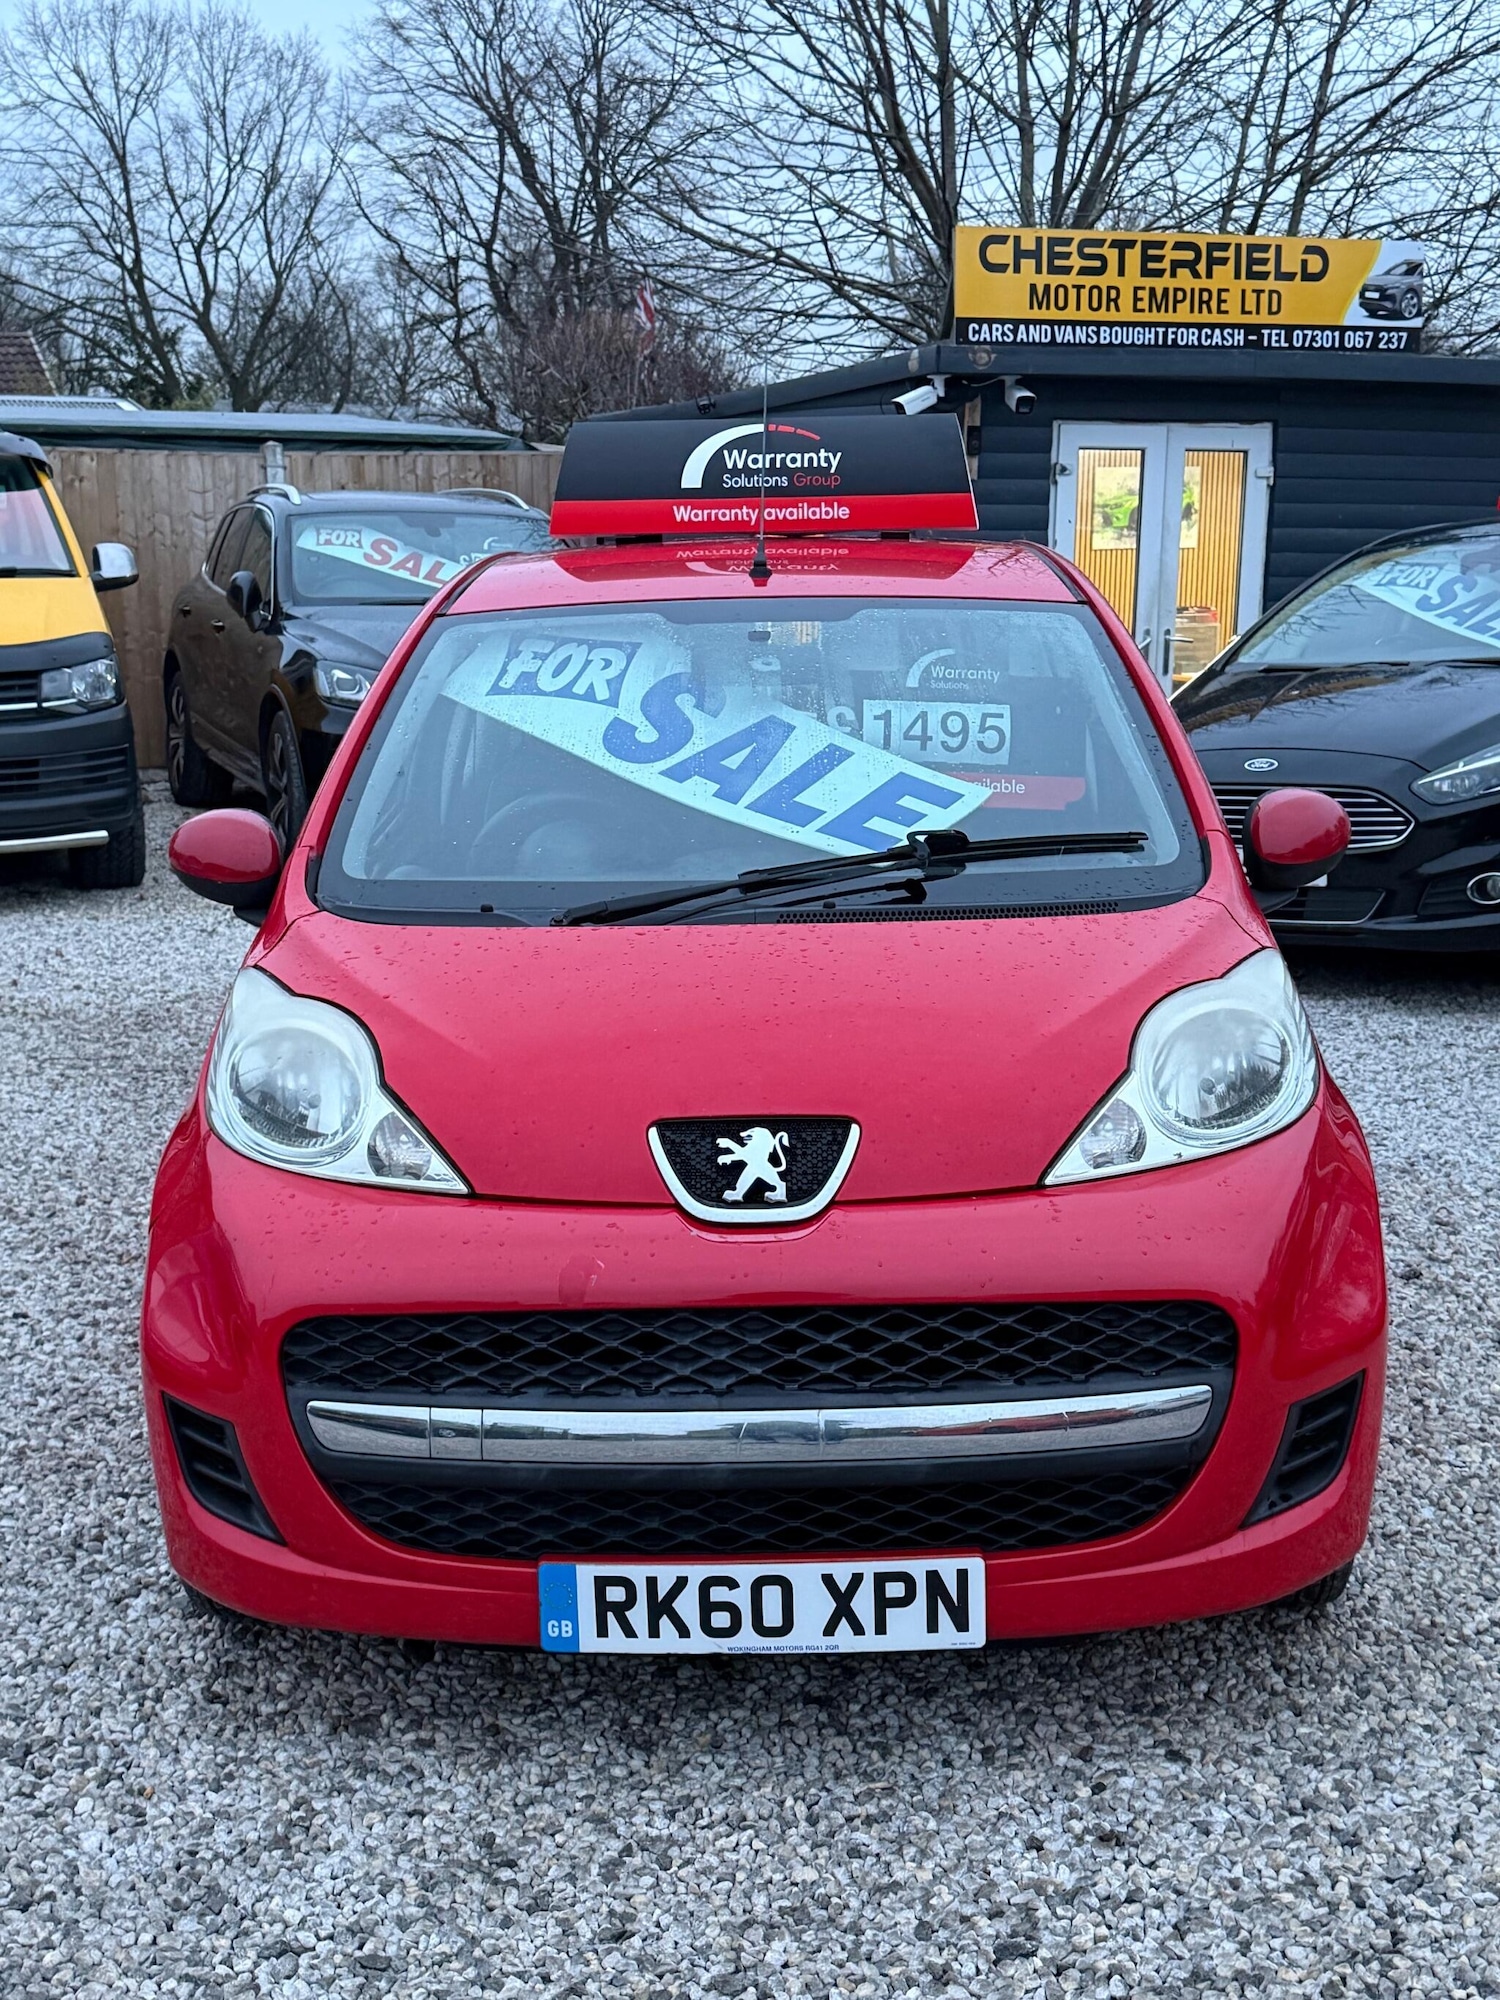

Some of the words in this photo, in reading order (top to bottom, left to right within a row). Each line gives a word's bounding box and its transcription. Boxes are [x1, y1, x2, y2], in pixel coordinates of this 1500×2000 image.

[978, 234, 1330, 283] CHESTERFIELD
[1029, 282, 1120, 312] MOTOR
[1133, 286, 1229, 315] EMPIRE
[1241, 289, 1283, 316] LTD
[968, 323, 1014, 343] CARS
[1016, 324, 1051, 343] AND
[1054, 325, 1098, 344] VANS
[1100, 326, 1166, 345] BOUGHT
[1167, 328, 1199, 346] FOR
[1201, 328, 1244, 347] CASH
[1261, 329, 1289, 347] TEL
[1293, 330, 1339, 348] 07301
[1344, 332, 1373, 348] 067
[1378, 332, 1408, 349] 237
[723, 446, 842, 474] Warranty
[722, 473, 788, 488] Solutions
[793, 473, 841, 488] Group
[673, 505, 758, 526] Warranty
[764, 503, 850, 521] available
[318, 529, 361, 547] FOR
[363, 538, 450, 585] SAL
[1379, 564, 1440, 588] FOR
[1415, 575, 1500, 640] SAL
[931, 665, 1000, 684] Warranty
[498, 638, 627, 701] FOR
[602, 672, 965, 853] SALE
[593, 1575, 793, 1639] RK60
[821, 1568, 970, 1636] XPN
[547, 1620, 573, 1638] GB
